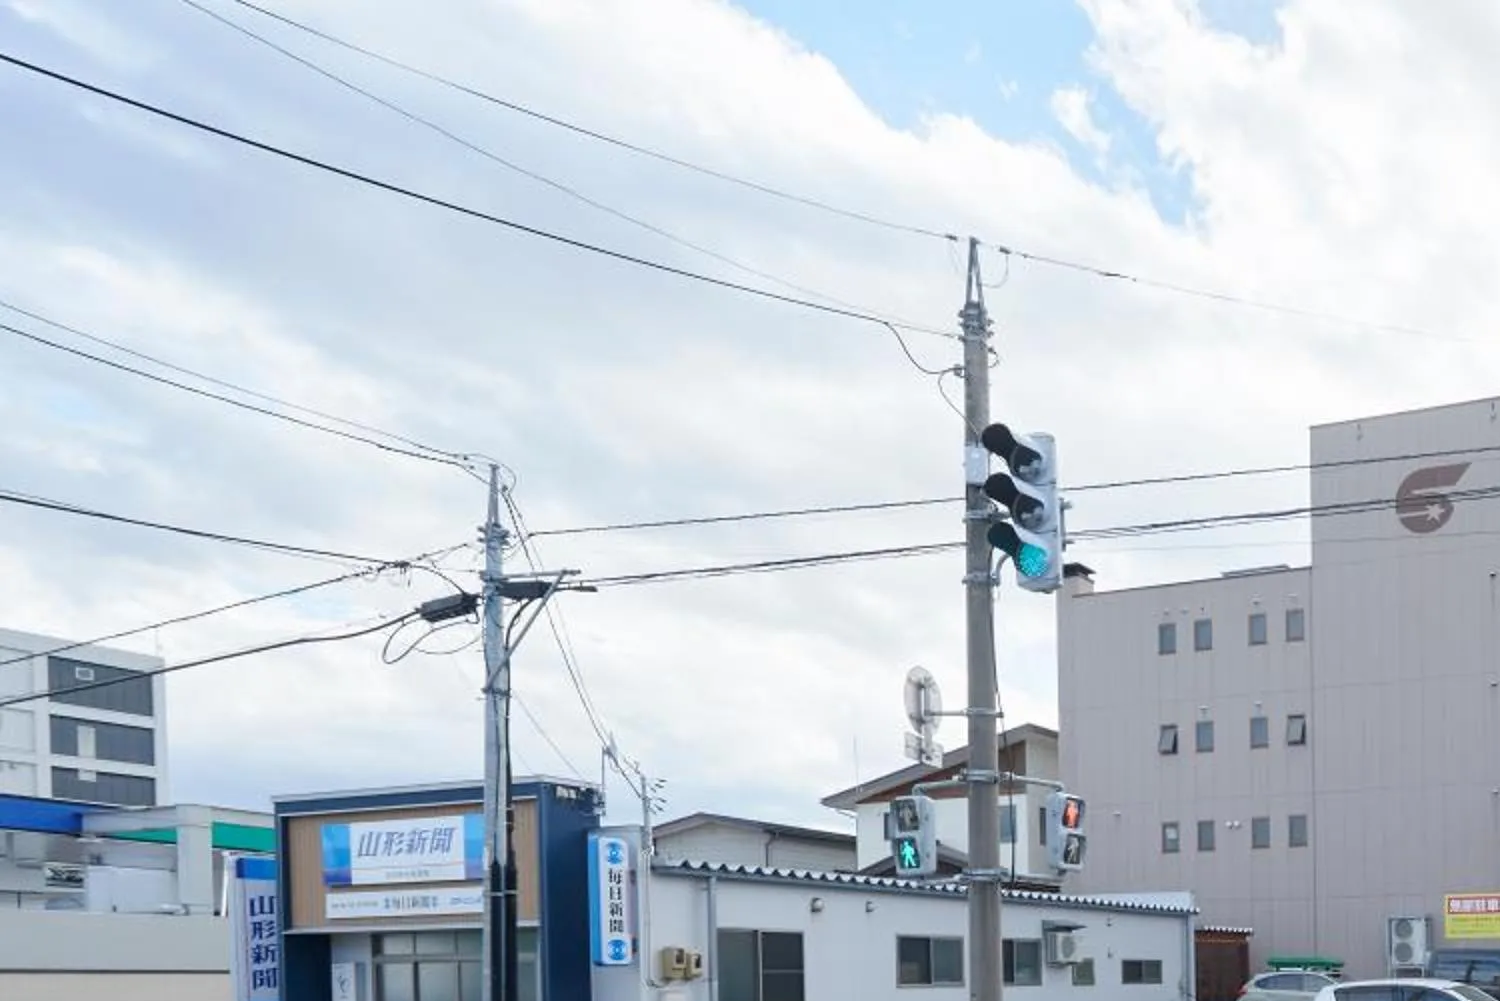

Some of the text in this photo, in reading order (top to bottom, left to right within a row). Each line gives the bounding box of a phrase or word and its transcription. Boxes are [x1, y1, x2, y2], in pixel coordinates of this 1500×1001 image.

[357, 827, 457, 858] 山形新聞
[608, 867, 625, 934] 毎日新聞
[249, 895, 279, 991] 山形新聞
